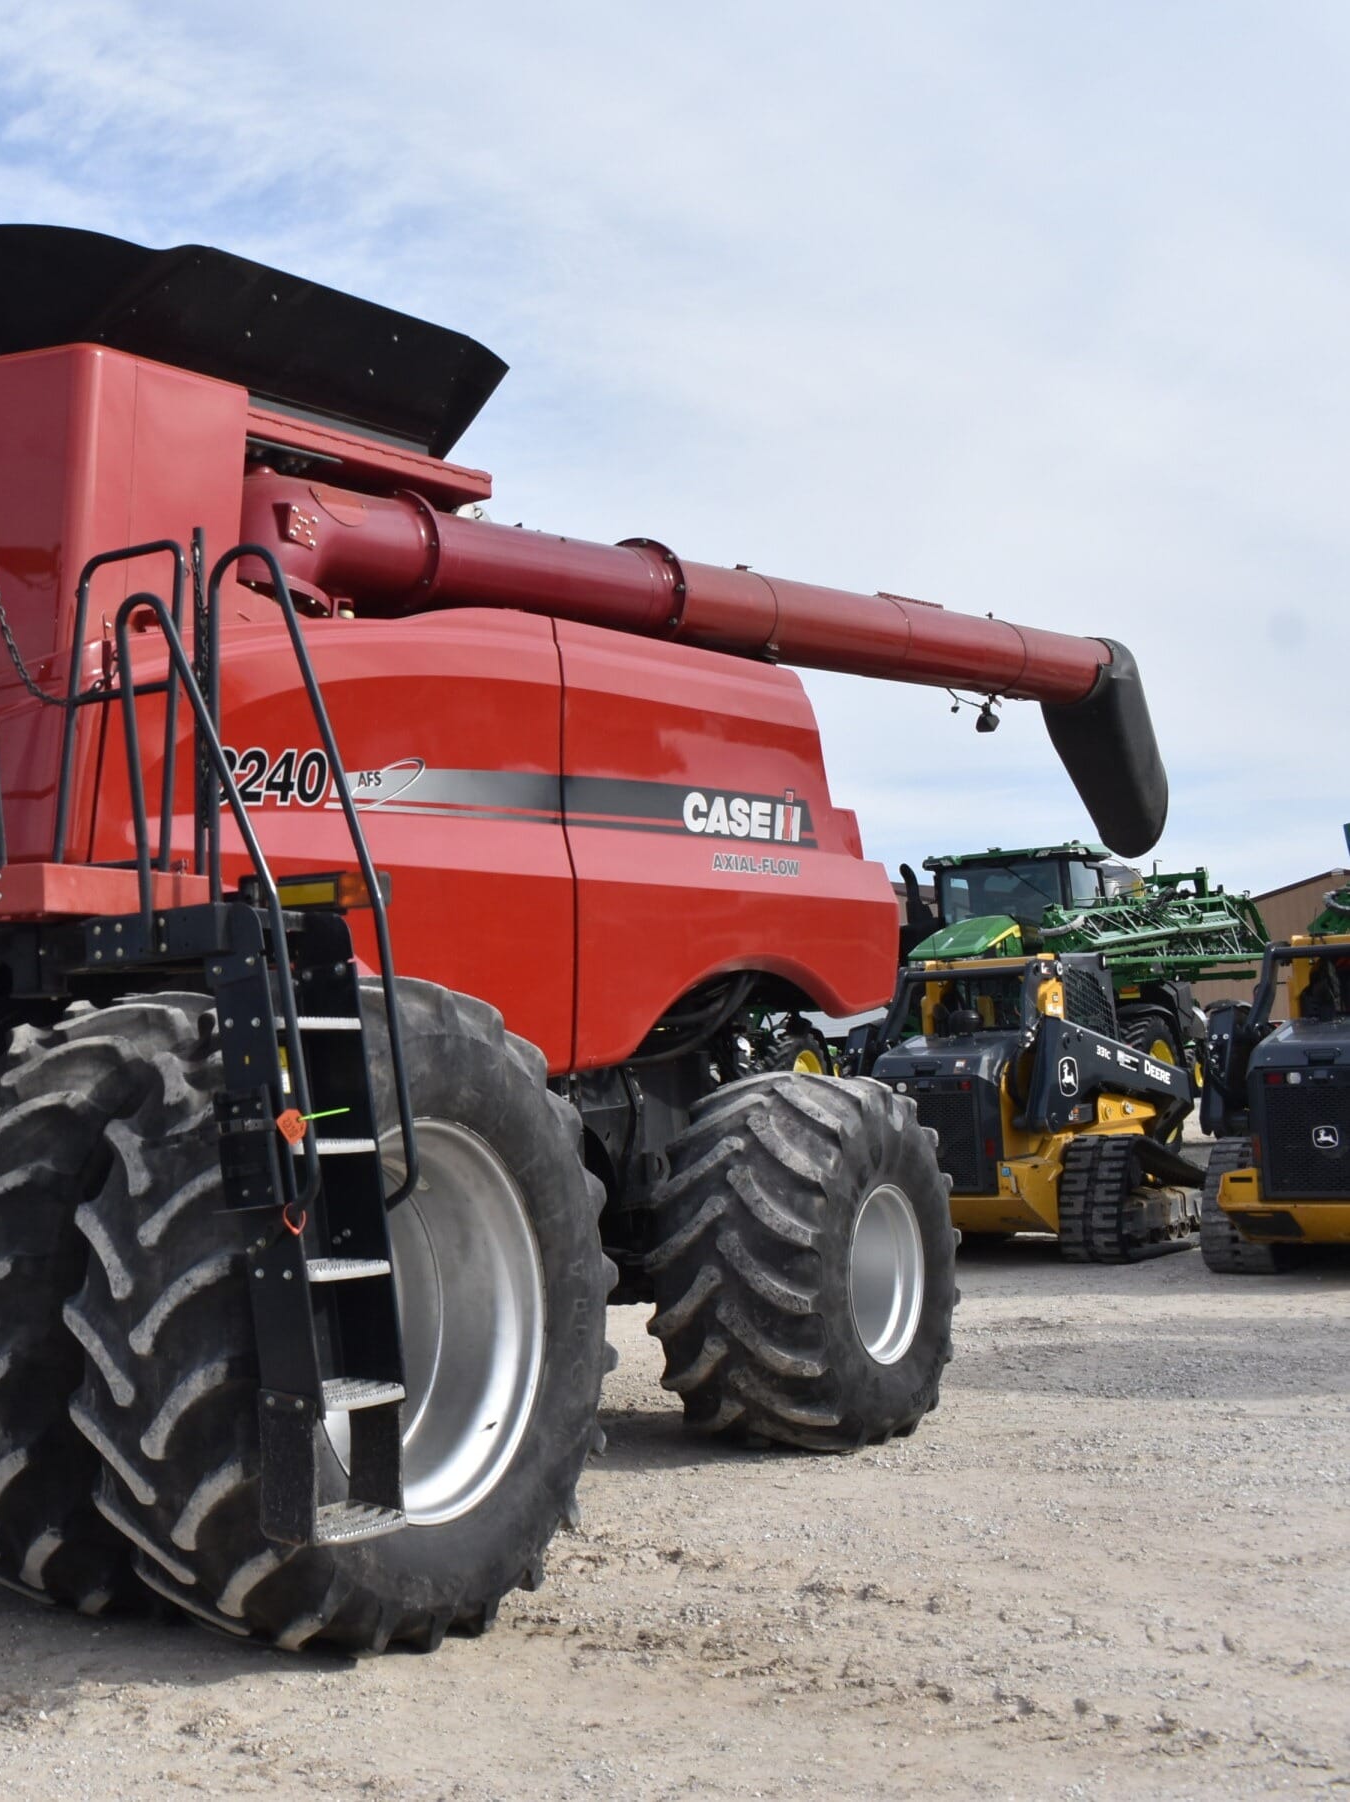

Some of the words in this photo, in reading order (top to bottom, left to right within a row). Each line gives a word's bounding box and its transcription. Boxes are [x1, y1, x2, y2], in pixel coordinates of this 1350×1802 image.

[357, 771, 383, 788] AFS
[682, 791, 772, 840] CASE
[712, 852, 801, 878] AXIAL-FLOW
[1144, 1058, 1172, 1086] DEERE
